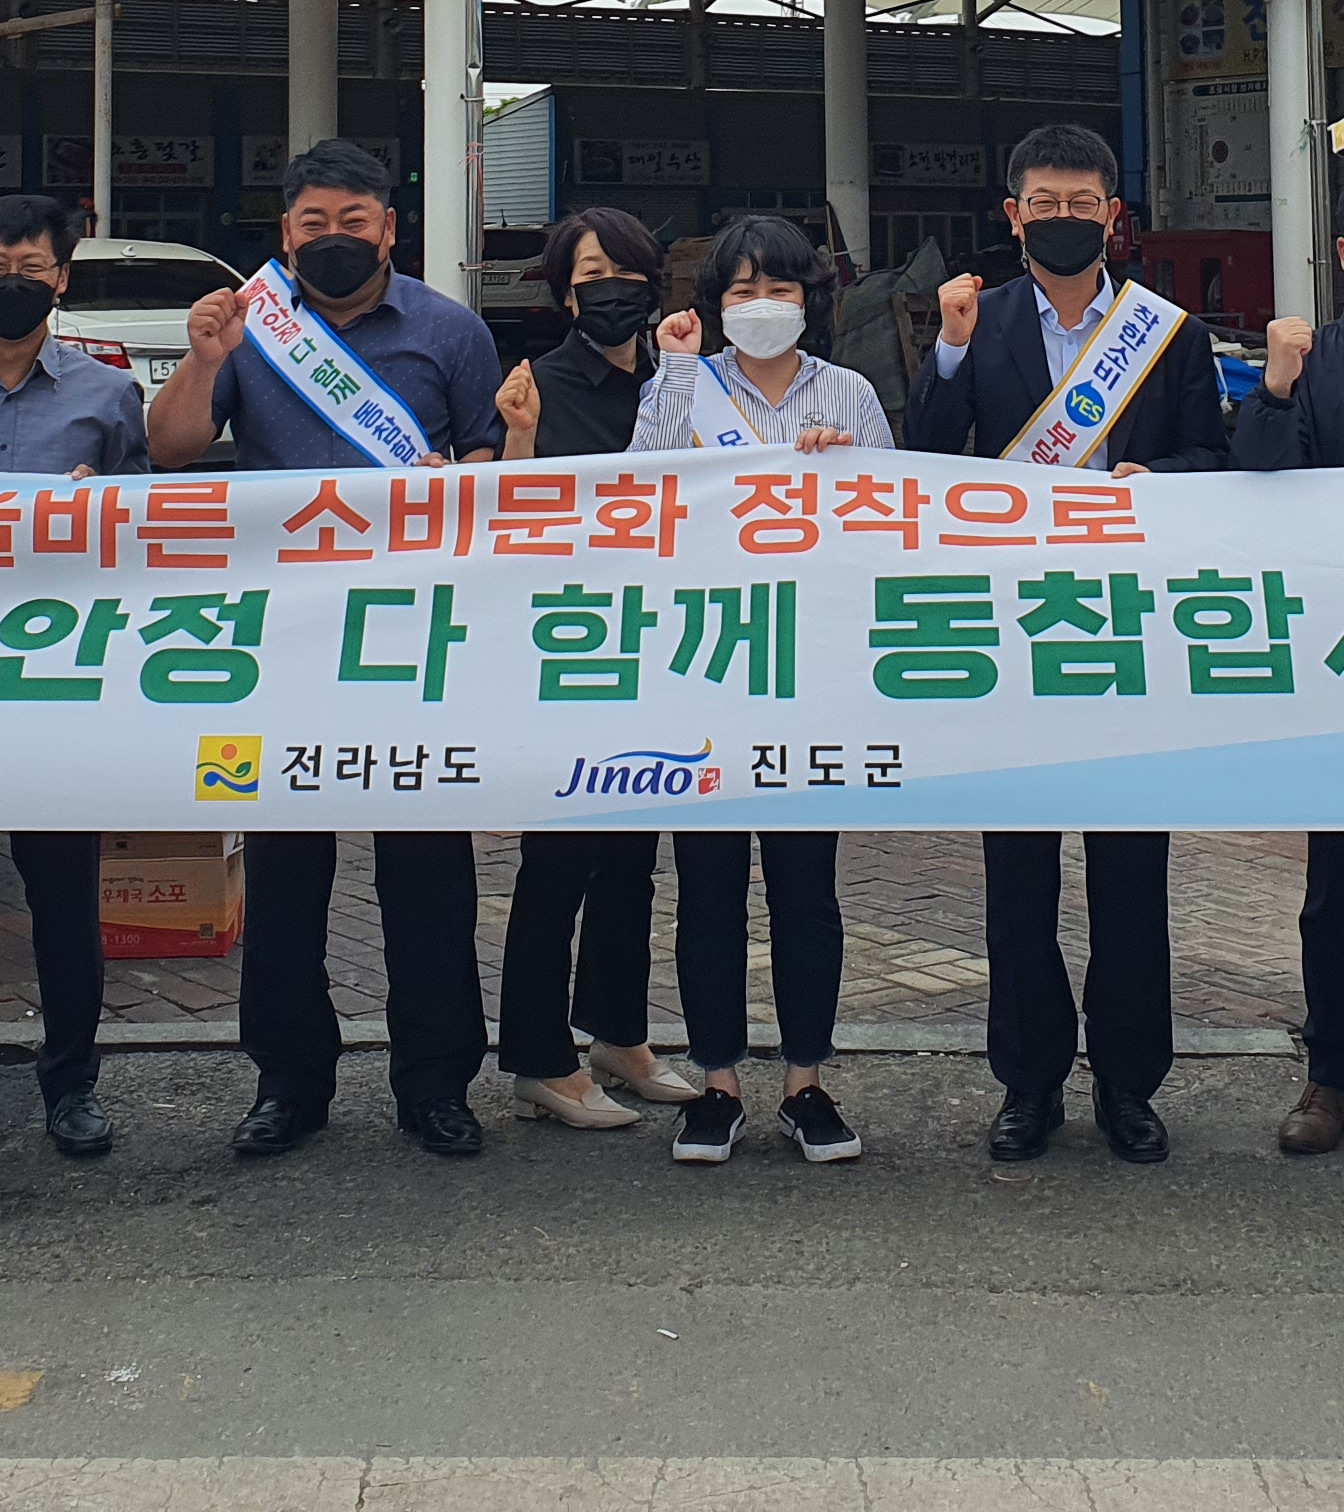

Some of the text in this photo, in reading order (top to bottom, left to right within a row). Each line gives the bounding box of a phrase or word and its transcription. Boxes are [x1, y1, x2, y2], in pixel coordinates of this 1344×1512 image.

[1093, 302, 1161, 391] 착한소비
[289, 336, 319, 365] 다
[309, 357, 362, 405] 함께
[353, 399, 422, 467] 동참합
[1069, 388, 1104, 423] YES
[277, 473, 688, 563] 소비문화
[730, 472, 1146, 554] 정착으로
[337, 584, 468, 702] 다
[530, 583, 796, 702] 함께
[281, 744, 481, 791] 전라남도
[554, 753, 693, 797] Jindo
[751, 744, 903, 788] 진도군
[147, 884, 188, 903] 소포
